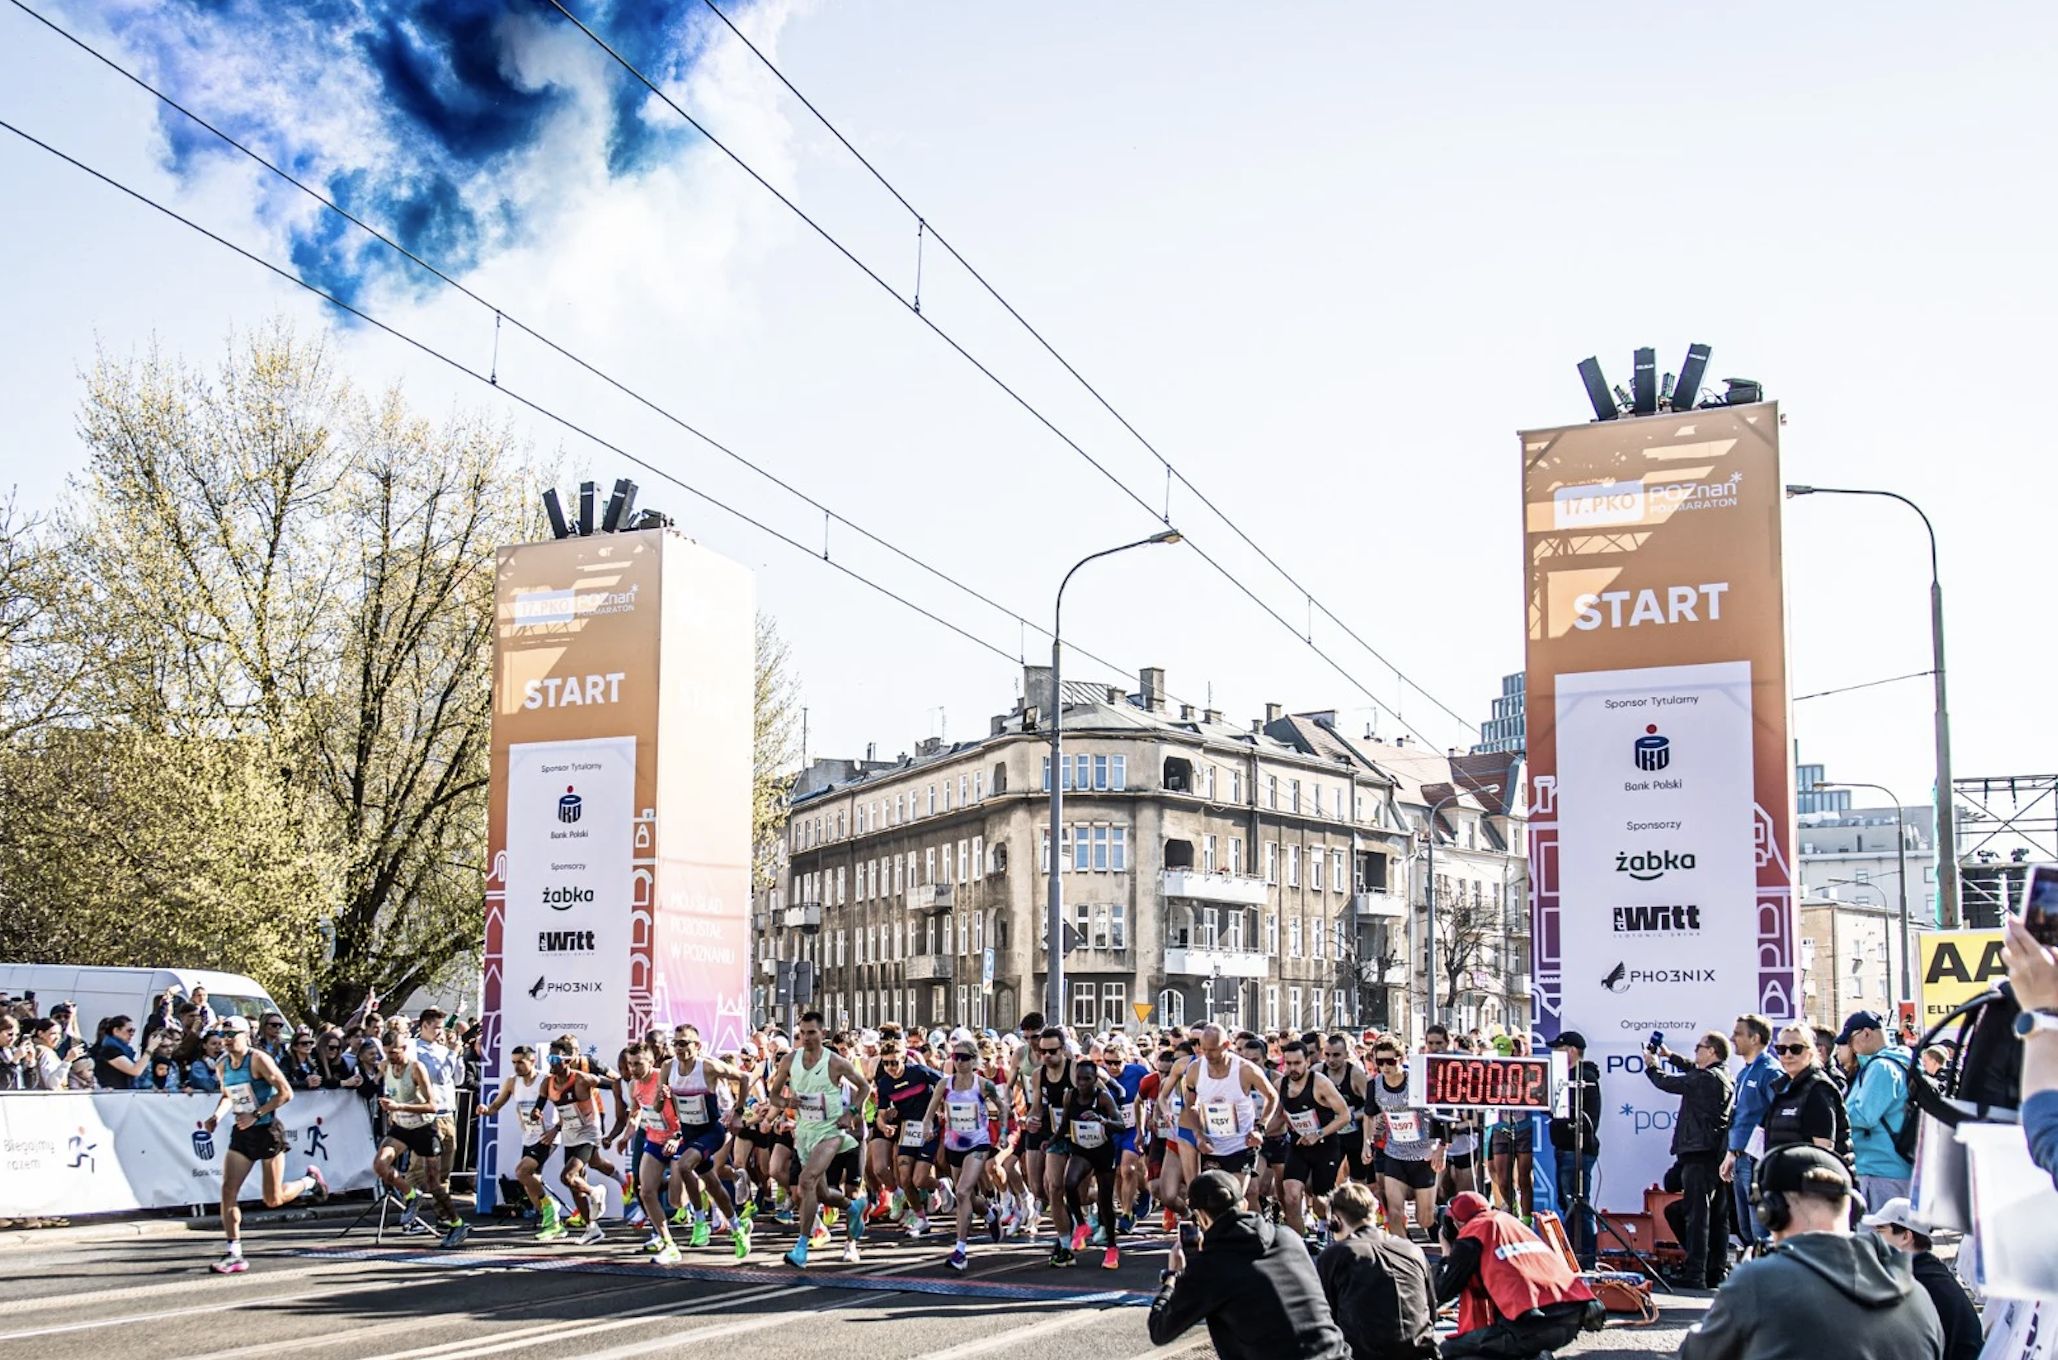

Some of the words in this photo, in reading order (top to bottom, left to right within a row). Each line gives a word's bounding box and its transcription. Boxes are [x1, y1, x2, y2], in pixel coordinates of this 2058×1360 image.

[1572, 582, 1729, 631] START
[523, 672, 626, 709] START
[1604, 699, 1648, 709] Sponsor
[1650, 696, 1699, 707] Tytularny
[541, 765, 569, 773] Sponsor
[1624, 781, 1650, 791] Bank
[1653, 779, 1682, 789] Polski
[1626, 821, 1682, 831] Sponsorzy
[550, 831, 568, 839] Bank
[569, 829, 589, 838] Polski
[551, 862, 586, 871] Sponsorzy
[1615, 850, 1696, 872] żabka
[542, 886, 594, 903] żabka
[539, 1022, 589, 1031] Organizatorzy
[1620, 1020, 1696, 1031] Organizatorzy
